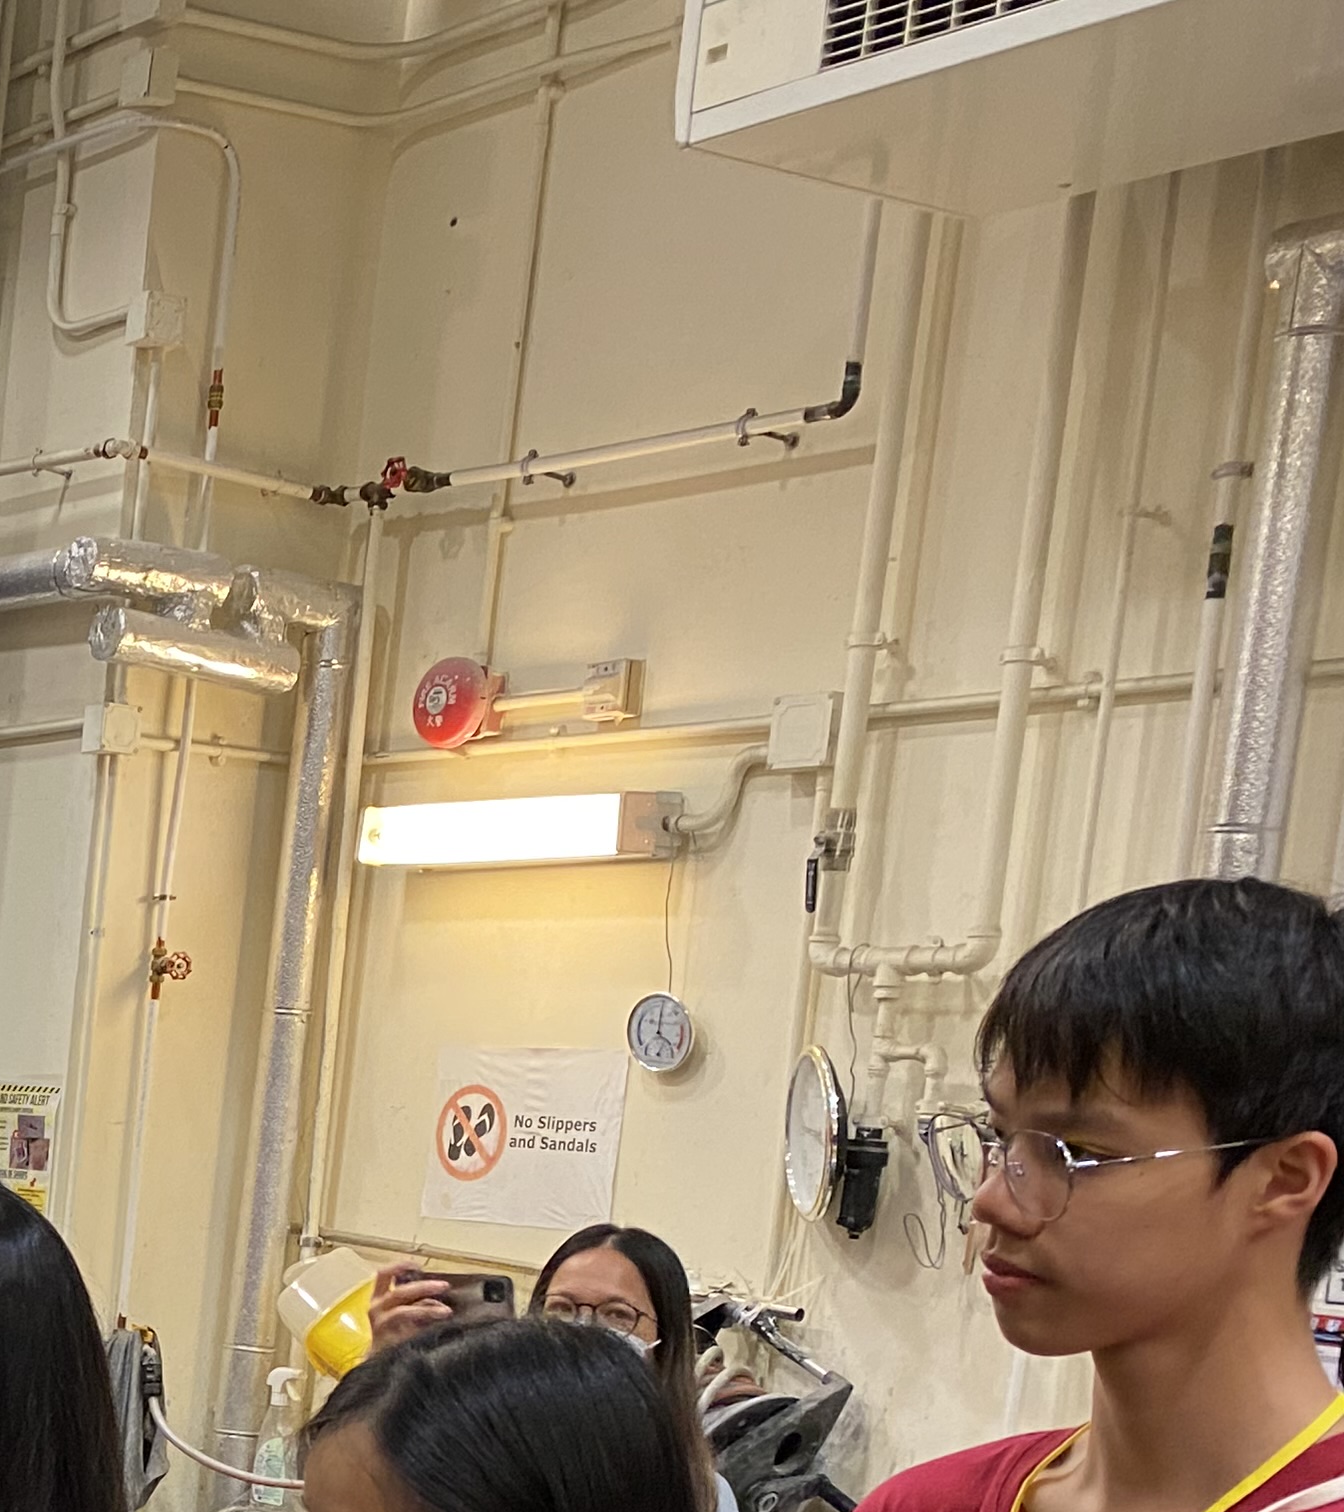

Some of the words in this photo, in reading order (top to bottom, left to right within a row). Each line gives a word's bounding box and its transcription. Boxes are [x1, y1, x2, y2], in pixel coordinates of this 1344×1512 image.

[10, 1093, 31, 1105] SAFETY
[31, 1094, 50, 1106] ALERT
[514, 1114, 533, 1129] No
[537, 1115, 597, 1134] Slippers
[509, 1135, 536, 1149] and
[539, 1136, 597, 1153] Sandals
